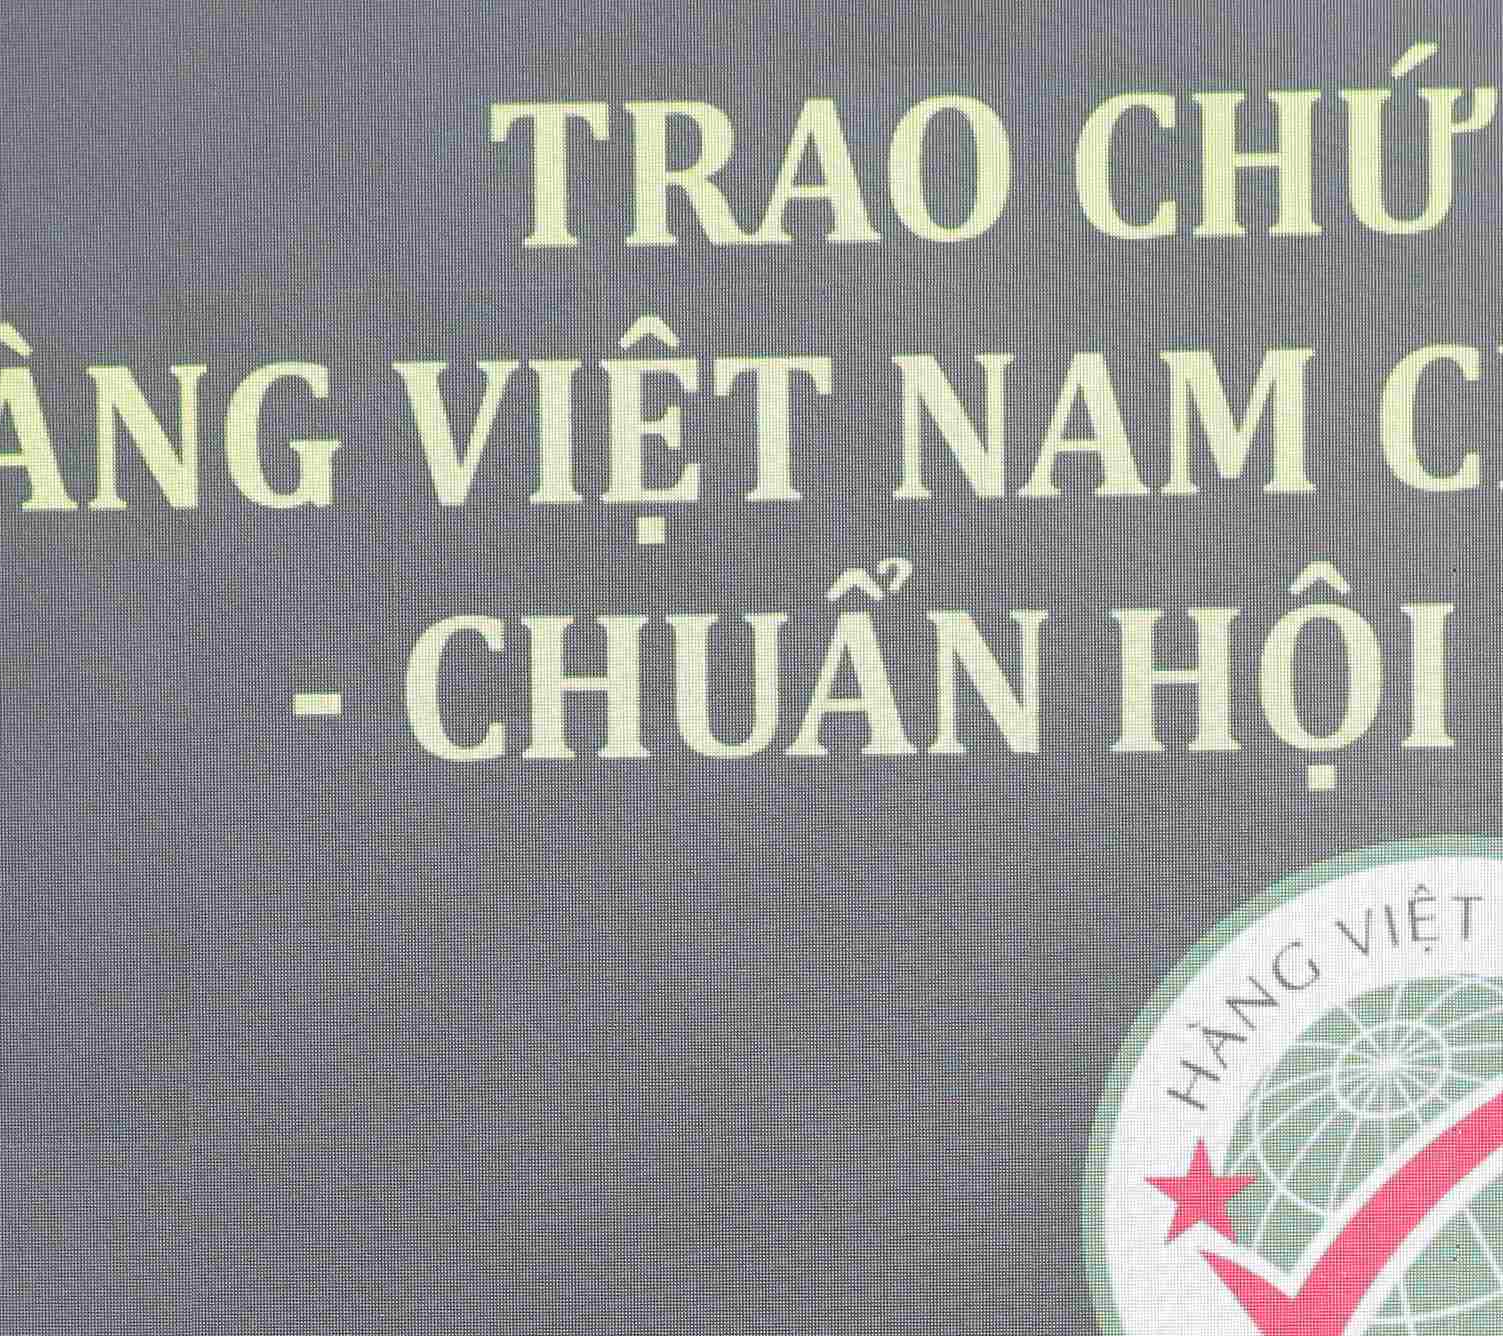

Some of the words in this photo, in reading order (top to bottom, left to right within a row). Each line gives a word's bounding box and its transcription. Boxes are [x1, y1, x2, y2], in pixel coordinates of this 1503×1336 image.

[491, 95, 1012, 247] TRAO
[392, 314, 833, 545] VIỆT
[894, 348, 1314, 499] NAM
[403, 557, 1049, 762] CHUẨN
[1111, 558, 1454, 791] HỘI
[1167, 940, 1322, 1113] HÀNG
[1335, 882, 1485, 962] VIỆT
